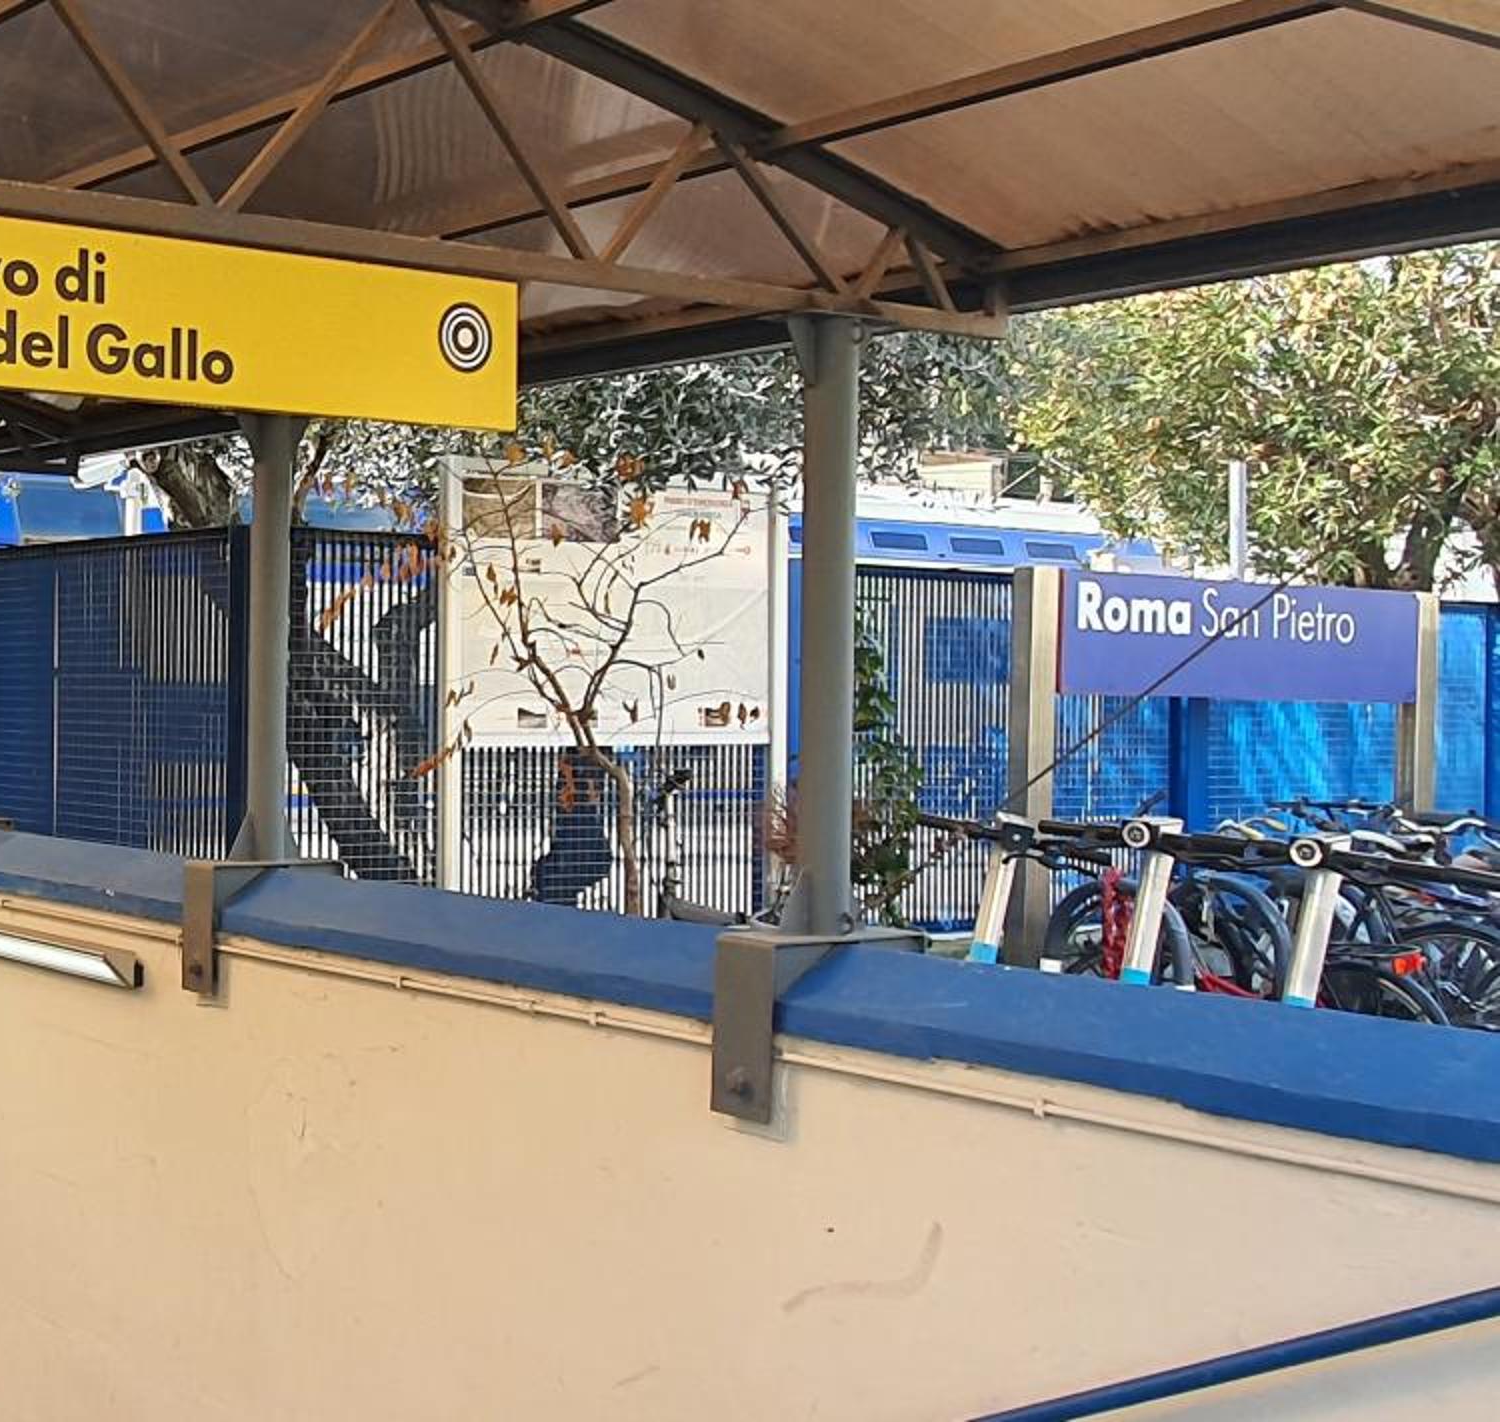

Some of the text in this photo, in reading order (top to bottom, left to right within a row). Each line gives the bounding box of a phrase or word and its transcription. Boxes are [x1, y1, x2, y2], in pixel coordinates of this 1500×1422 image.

[54, 247, 107, 305] di
[85, 322, 235, 385] Gallo
[1076, 580, 1356, 645] Roma San Pietro
